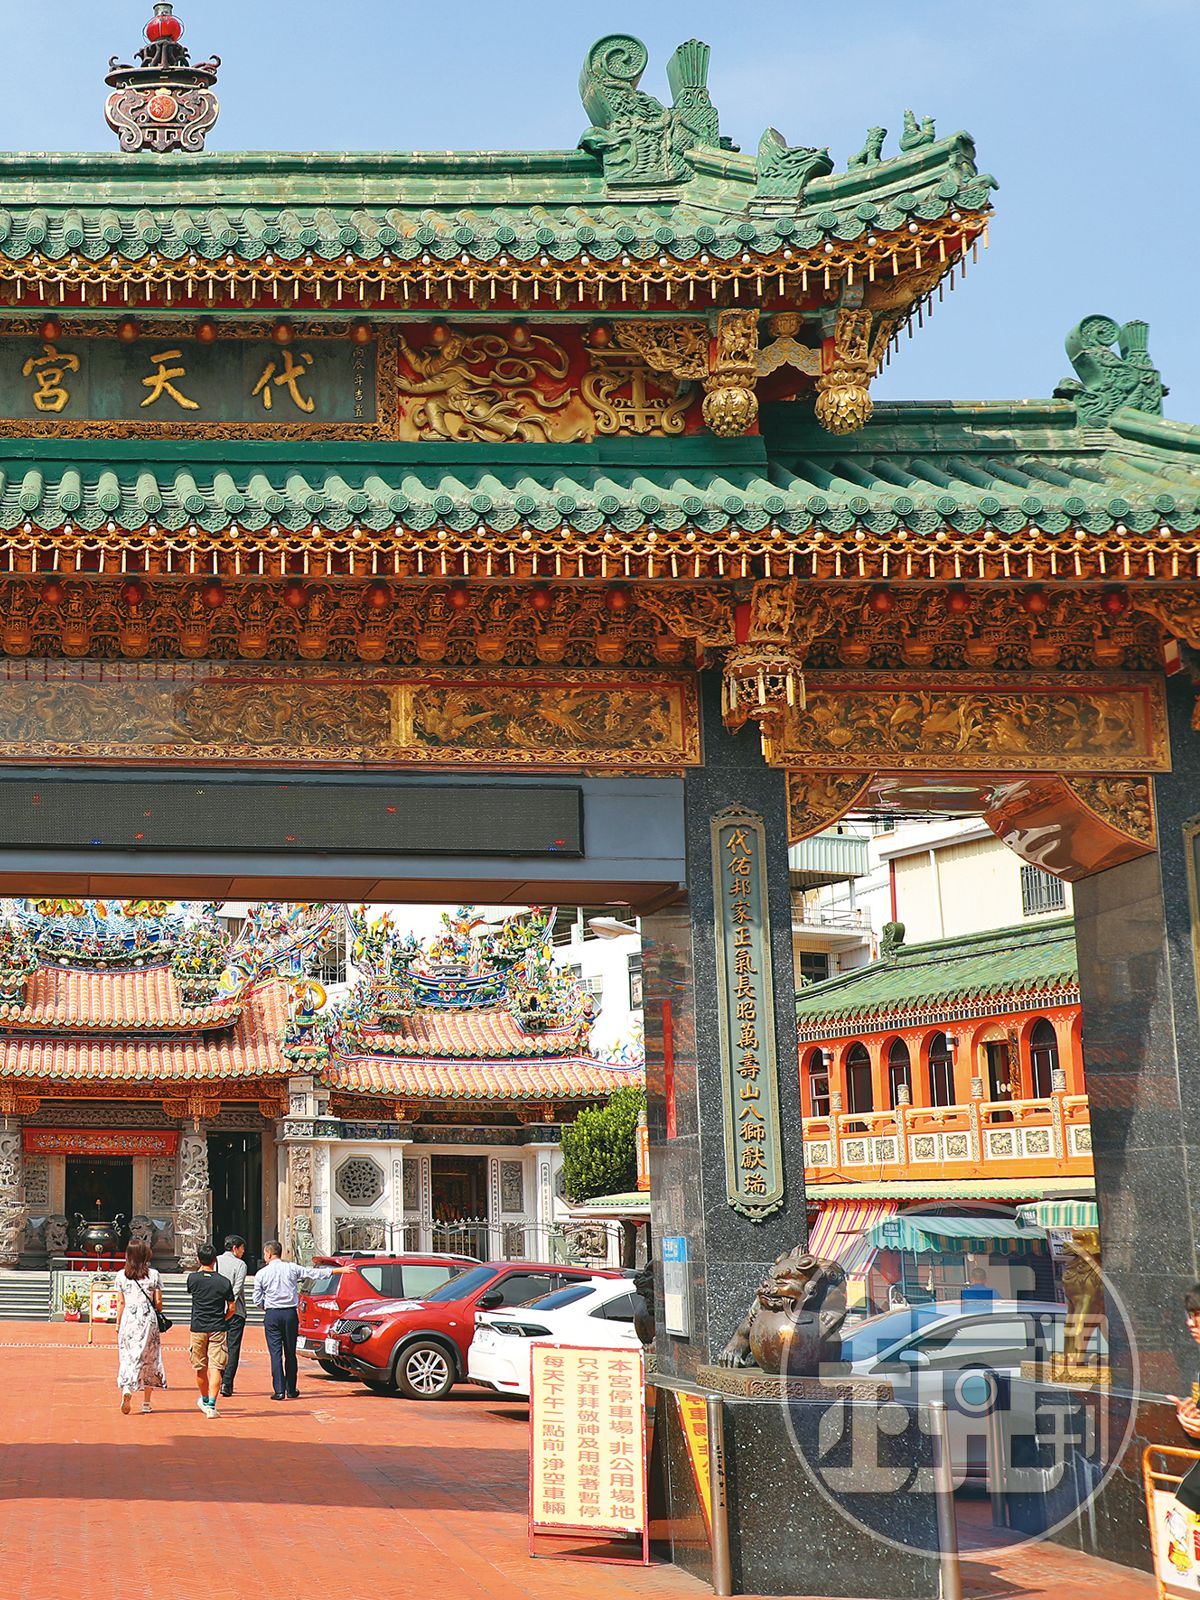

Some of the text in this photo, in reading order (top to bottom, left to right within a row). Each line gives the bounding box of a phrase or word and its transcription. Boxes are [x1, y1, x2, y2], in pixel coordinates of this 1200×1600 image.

[22, 344, 316, 414] 代天宮
[726, 828, 766, 1195] 代佑邦家正氣長昭萬壽山八獅獻瑞
[577, 1357, 601, 1518] 只予拜拜敬神及用餐者暫停
